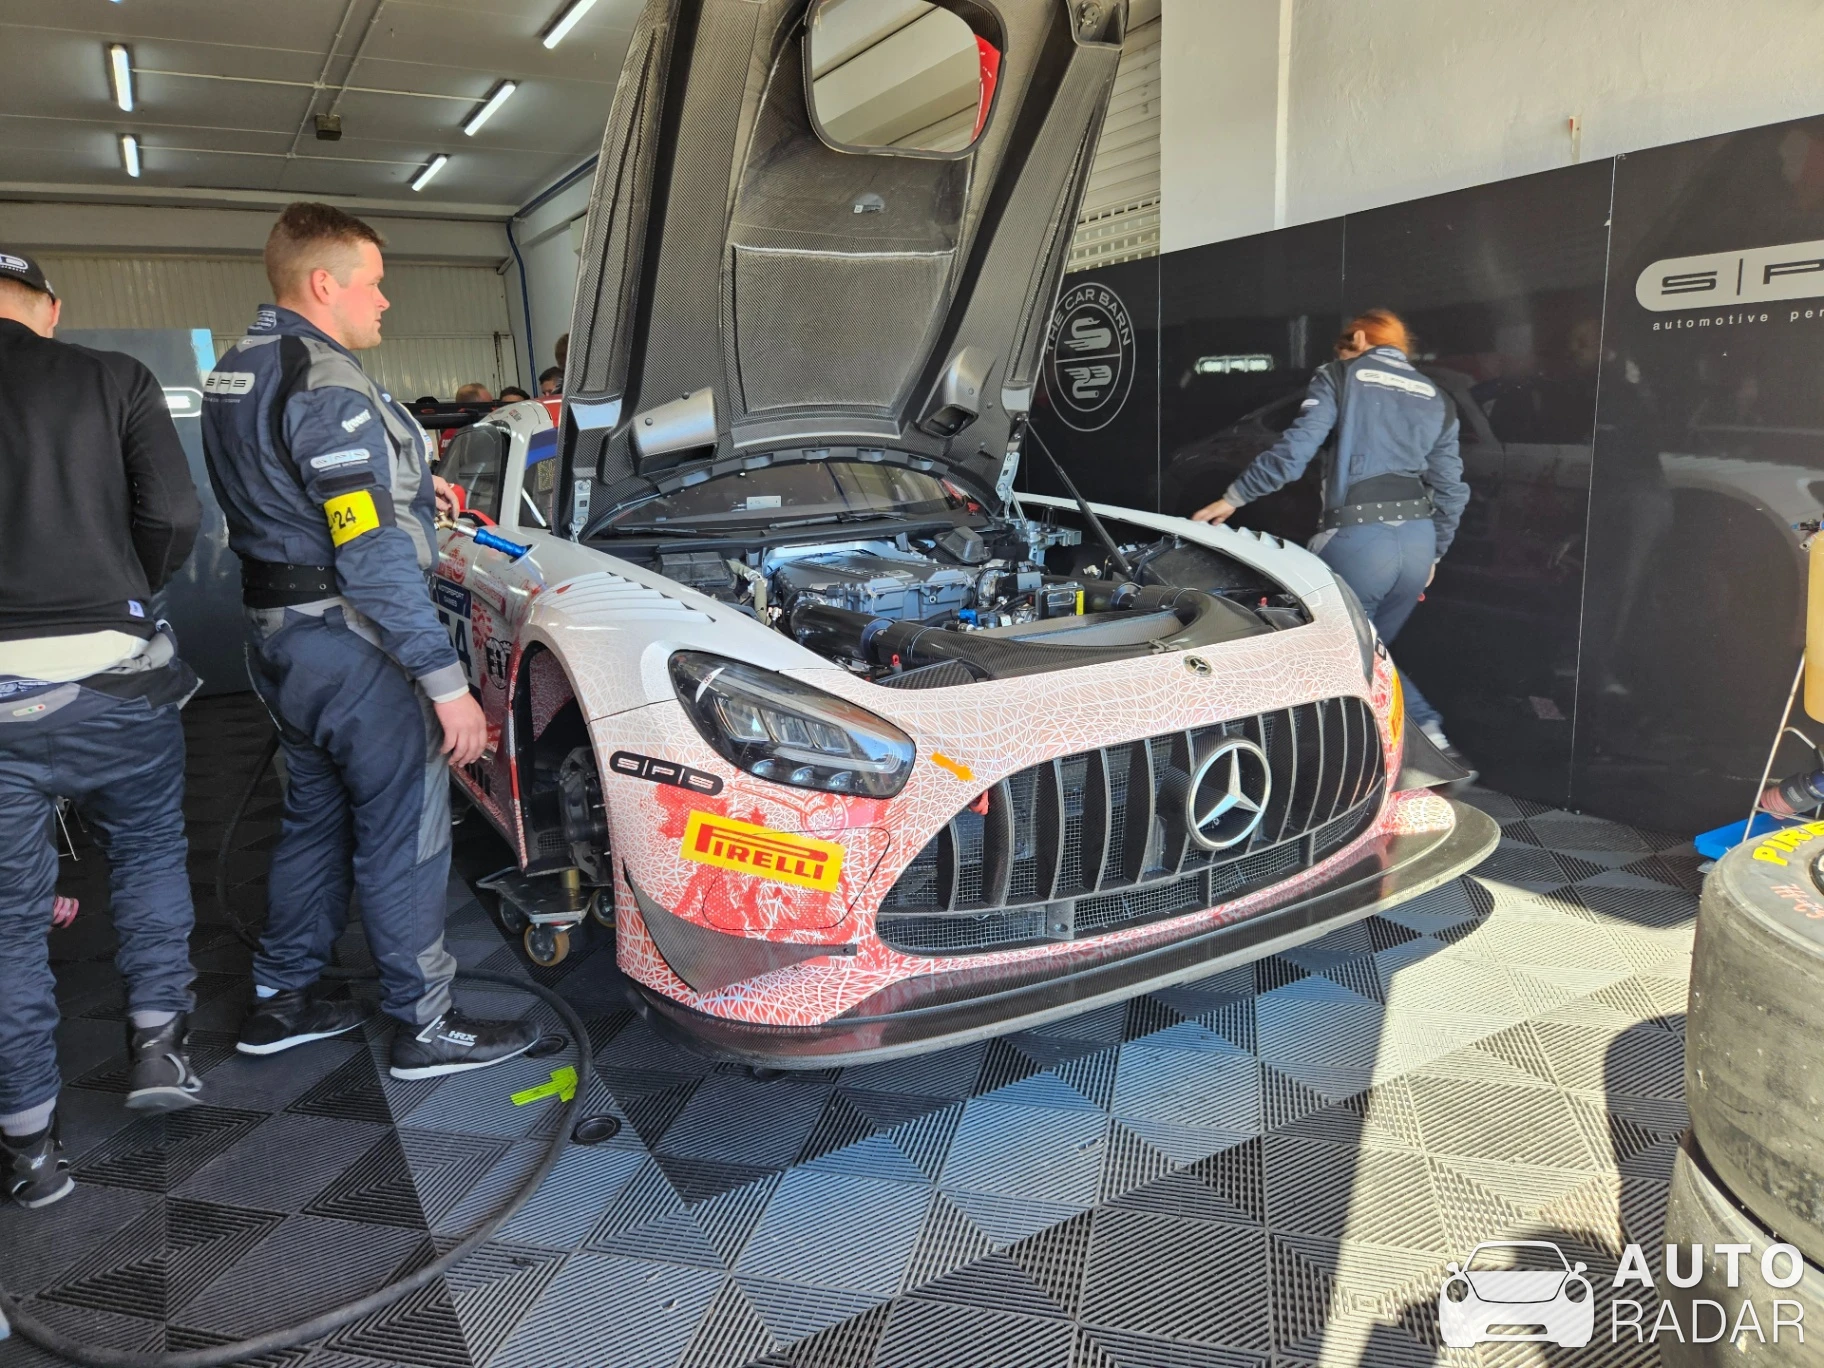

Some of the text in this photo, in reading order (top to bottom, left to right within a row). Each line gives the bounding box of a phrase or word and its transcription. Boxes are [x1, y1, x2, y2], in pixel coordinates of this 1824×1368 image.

[1046, 289, 1132, 354] THE CAR BARN
[1652, 313, 1769, 331] automotive
[694, 822, 829, 881] PIRELLI
